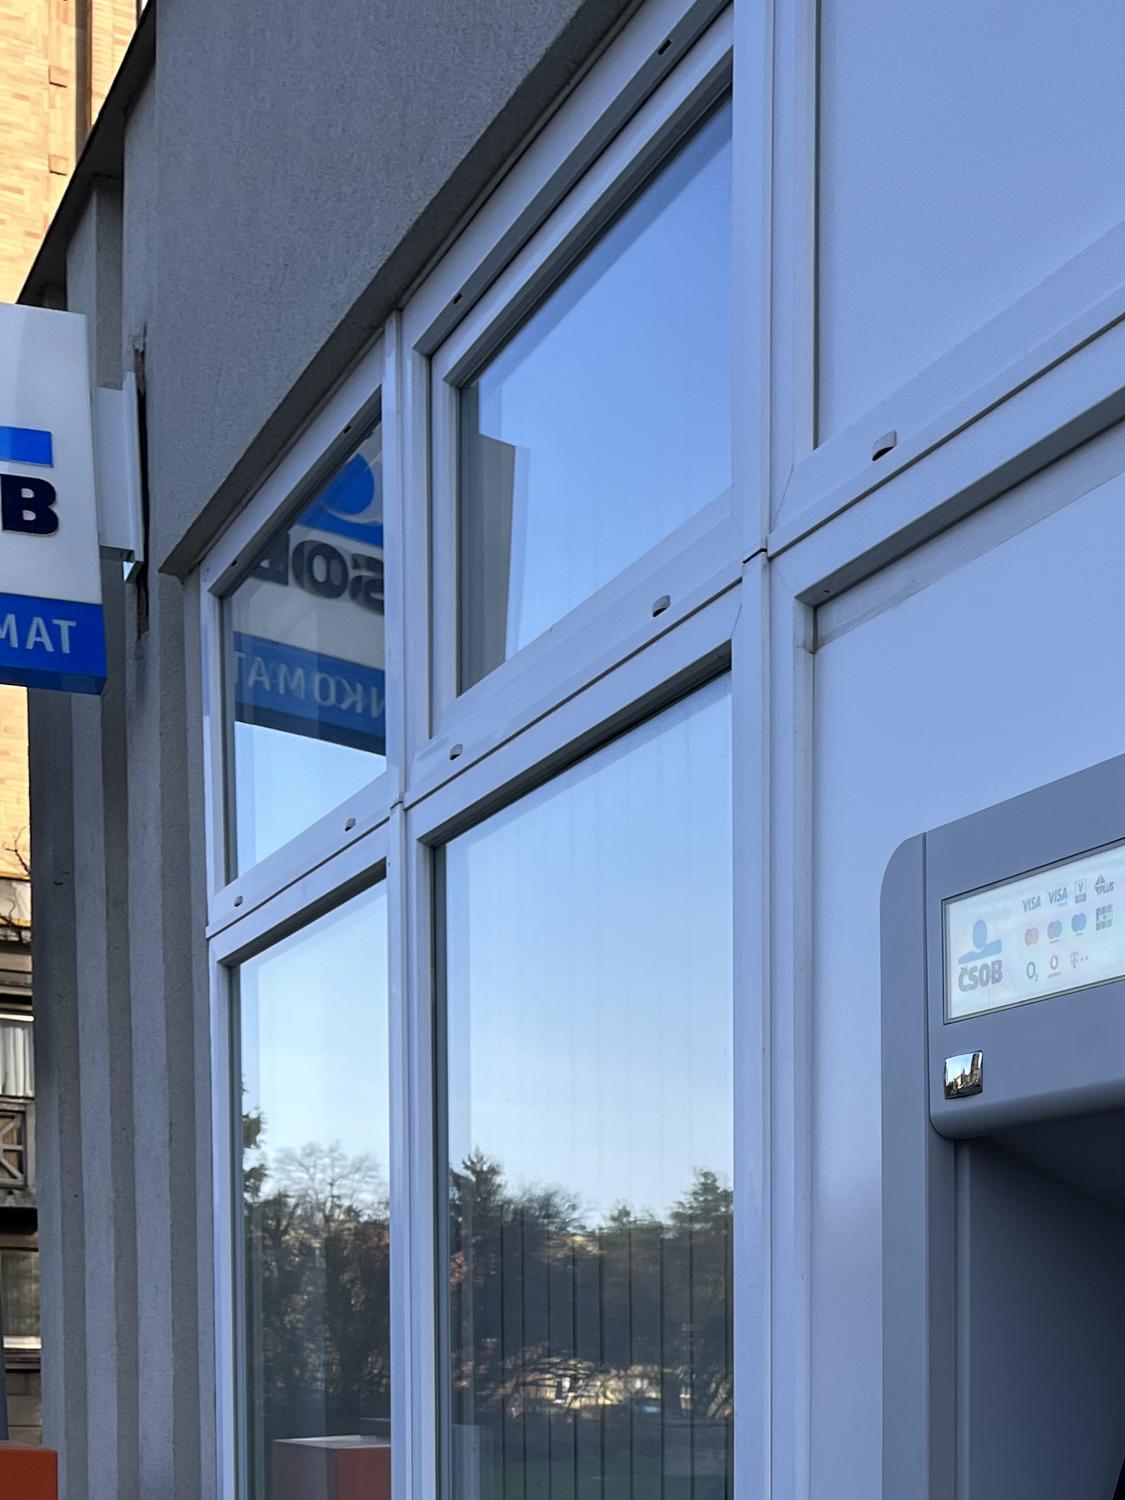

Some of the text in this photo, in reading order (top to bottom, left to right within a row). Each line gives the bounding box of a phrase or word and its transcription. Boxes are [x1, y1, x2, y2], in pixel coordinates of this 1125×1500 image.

[1, 474, 60, 535] B
[1022, 895, 1042, 913] VISA
[1048, 887, 1068, 905] VISA
[958, 959, 1003, 992] ČSOB
